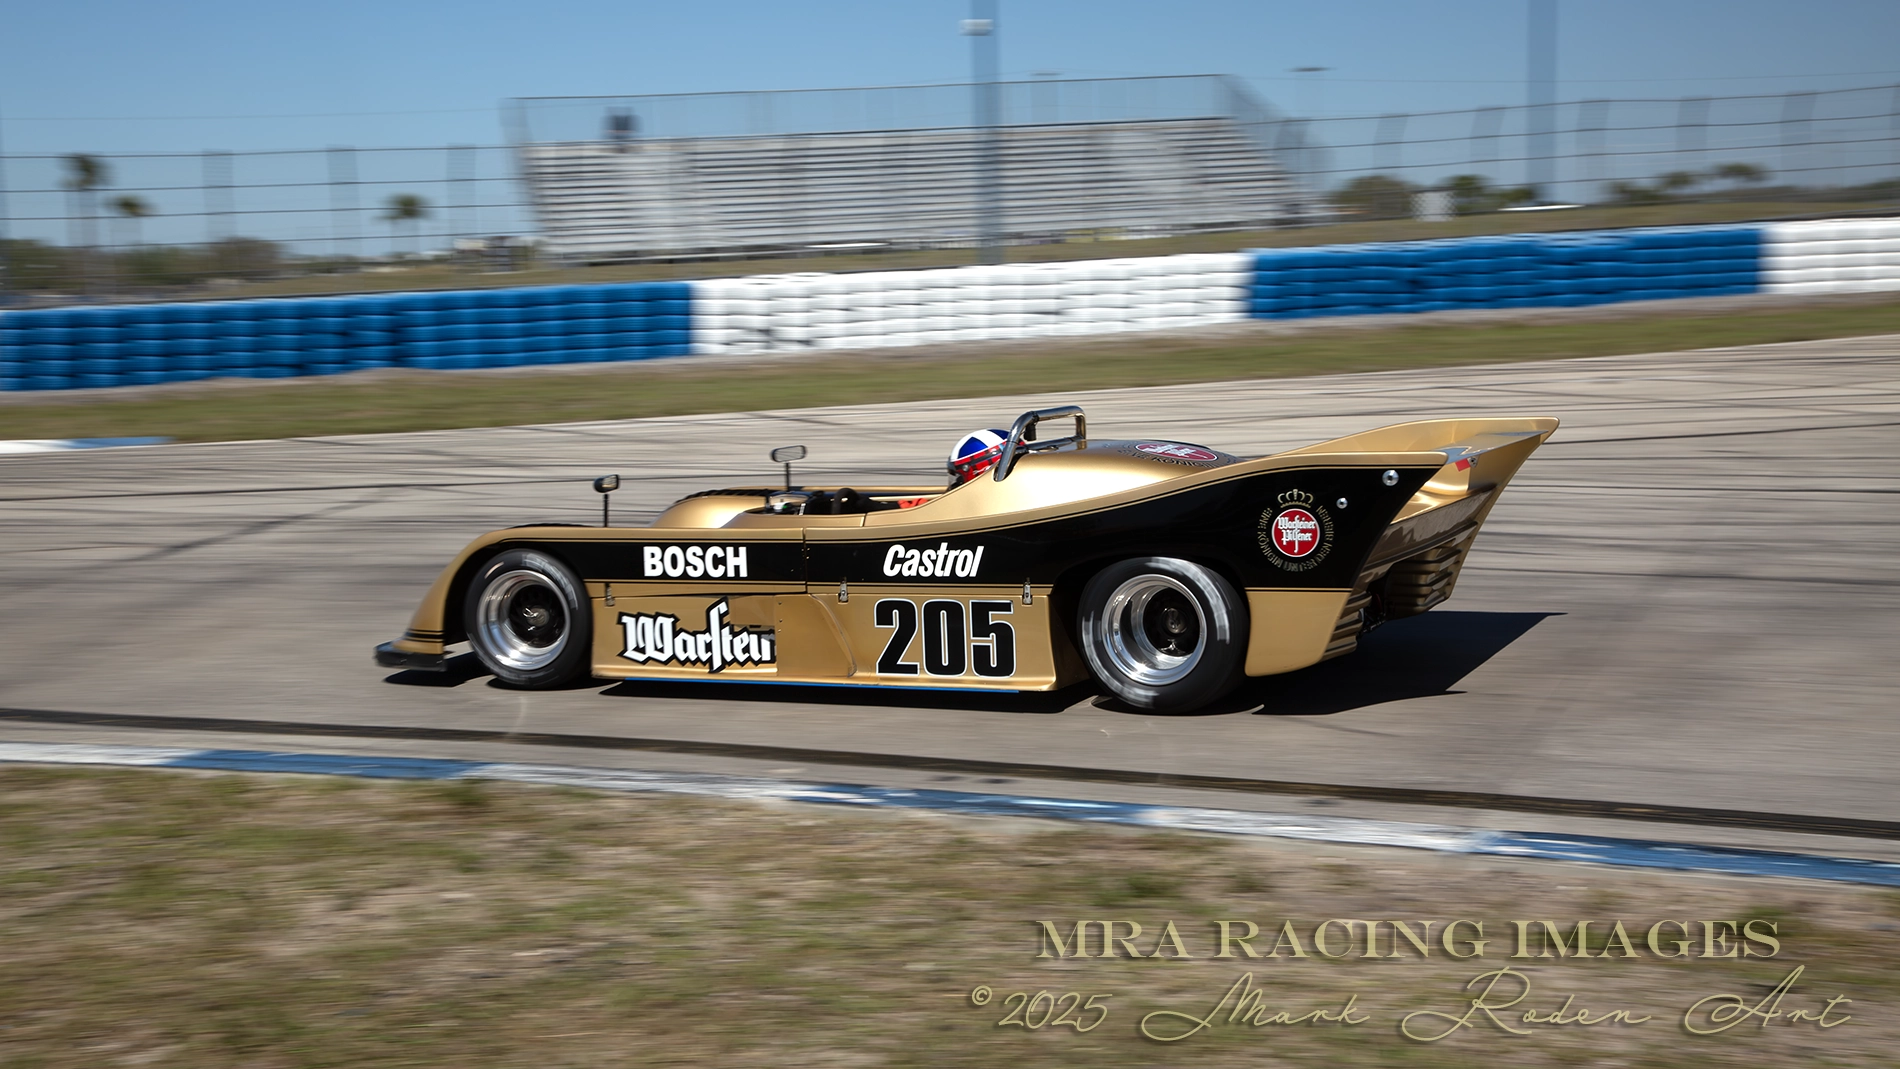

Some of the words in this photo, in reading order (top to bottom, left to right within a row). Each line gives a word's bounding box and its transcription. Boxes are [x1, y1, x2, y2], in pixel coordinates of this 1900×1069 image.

[643, 546, 748, 578] BOSCH
[882, 542, 985, 578] Castrol
[873, 597, 1017, 678] 205
